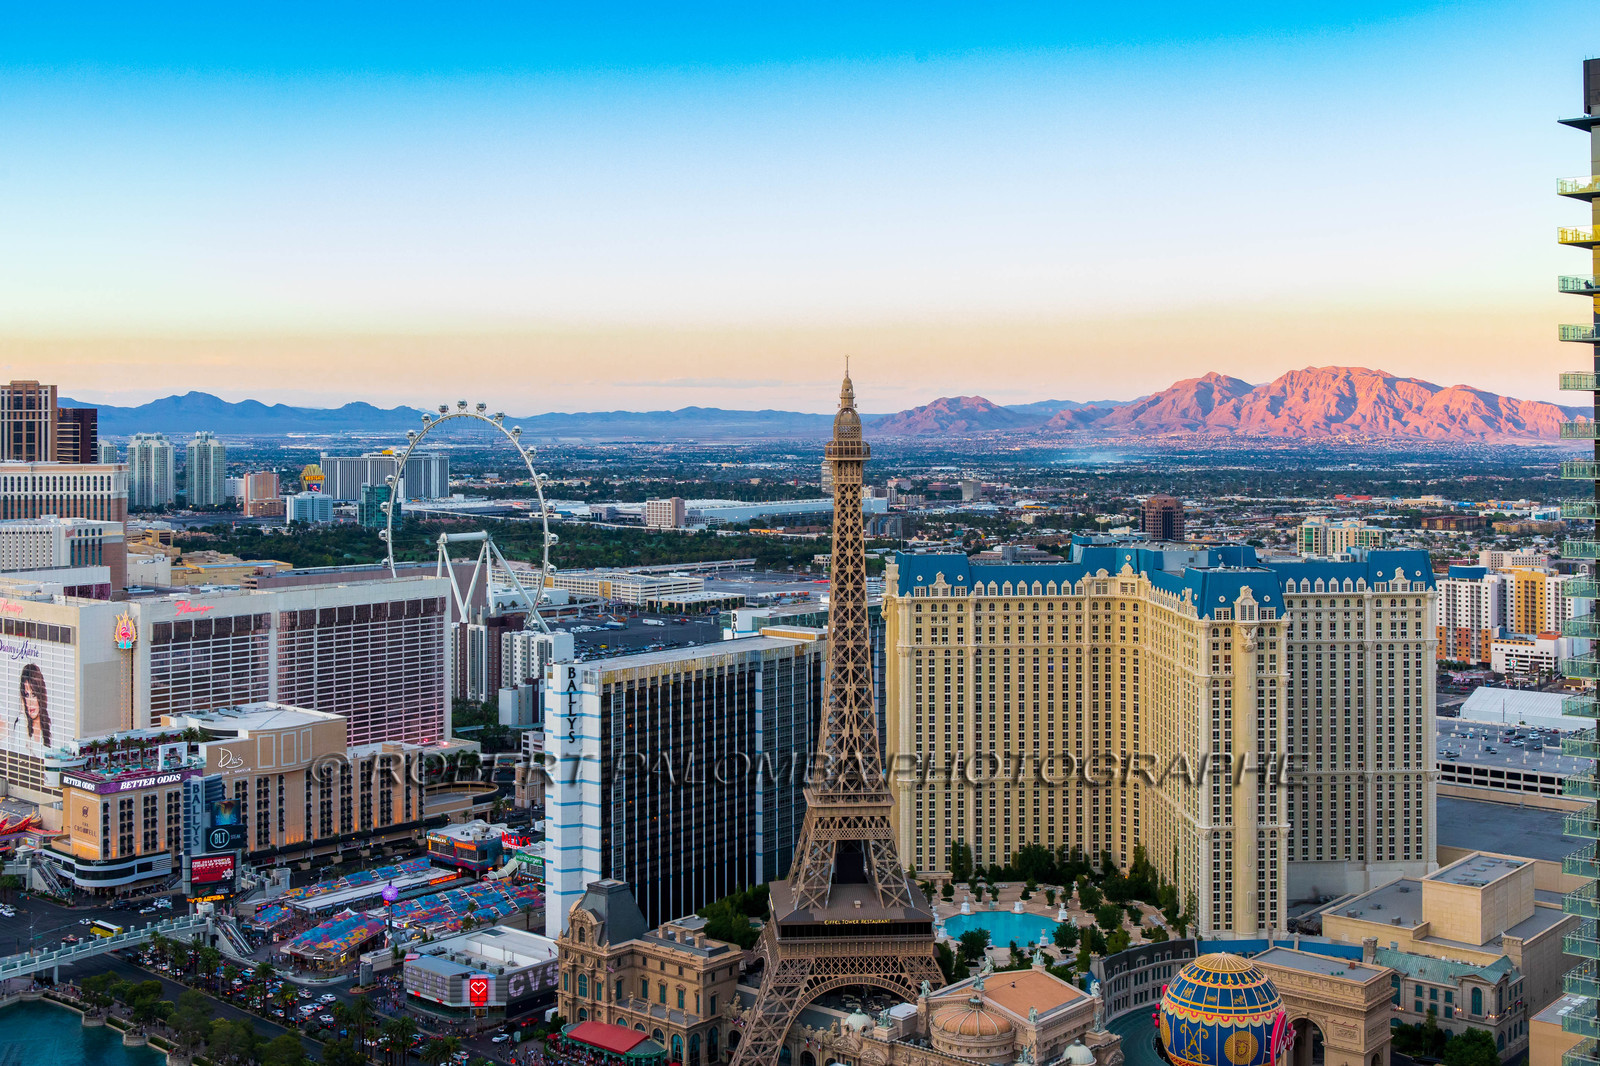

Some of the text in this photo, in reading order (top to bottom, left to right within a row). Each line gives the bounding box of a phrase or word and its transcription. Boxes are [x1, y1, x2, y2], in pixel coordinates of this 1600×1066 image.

[566, 666, 577, 744] BALLYS
[63, 776, 81, 787] BETTER
[82, 781, 95, 791] ODDS
[120, 774, 182, 790] BETTER ODDS
[191, 784, 201, 847] BALLYS
[214, 832, 226, 845] BLT
[508, 961, 559, 998] CVS
